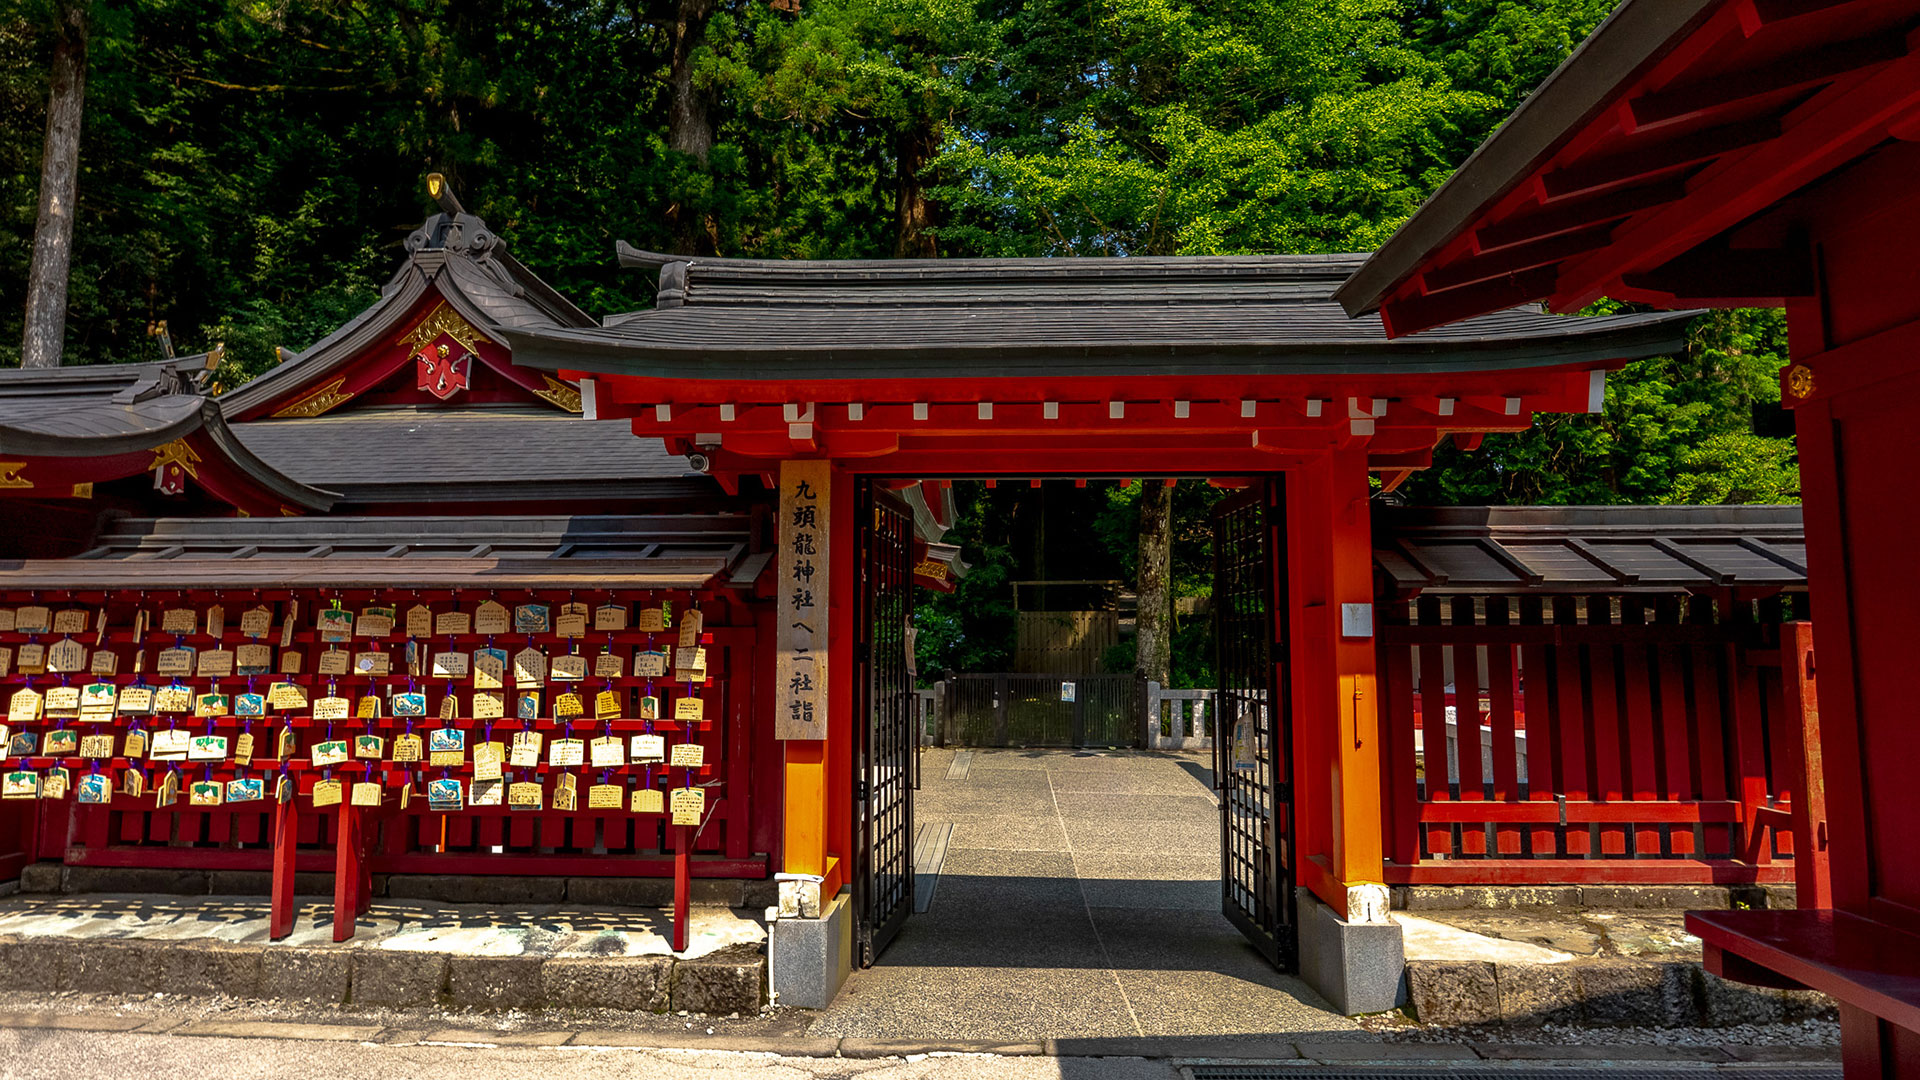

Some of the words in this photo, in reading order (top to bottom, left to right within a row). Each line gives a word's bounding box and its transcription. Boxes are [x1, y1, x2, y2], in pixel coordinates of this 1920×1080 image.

[789, 480, 816, 722] 九頭龍神社へ二社詣
